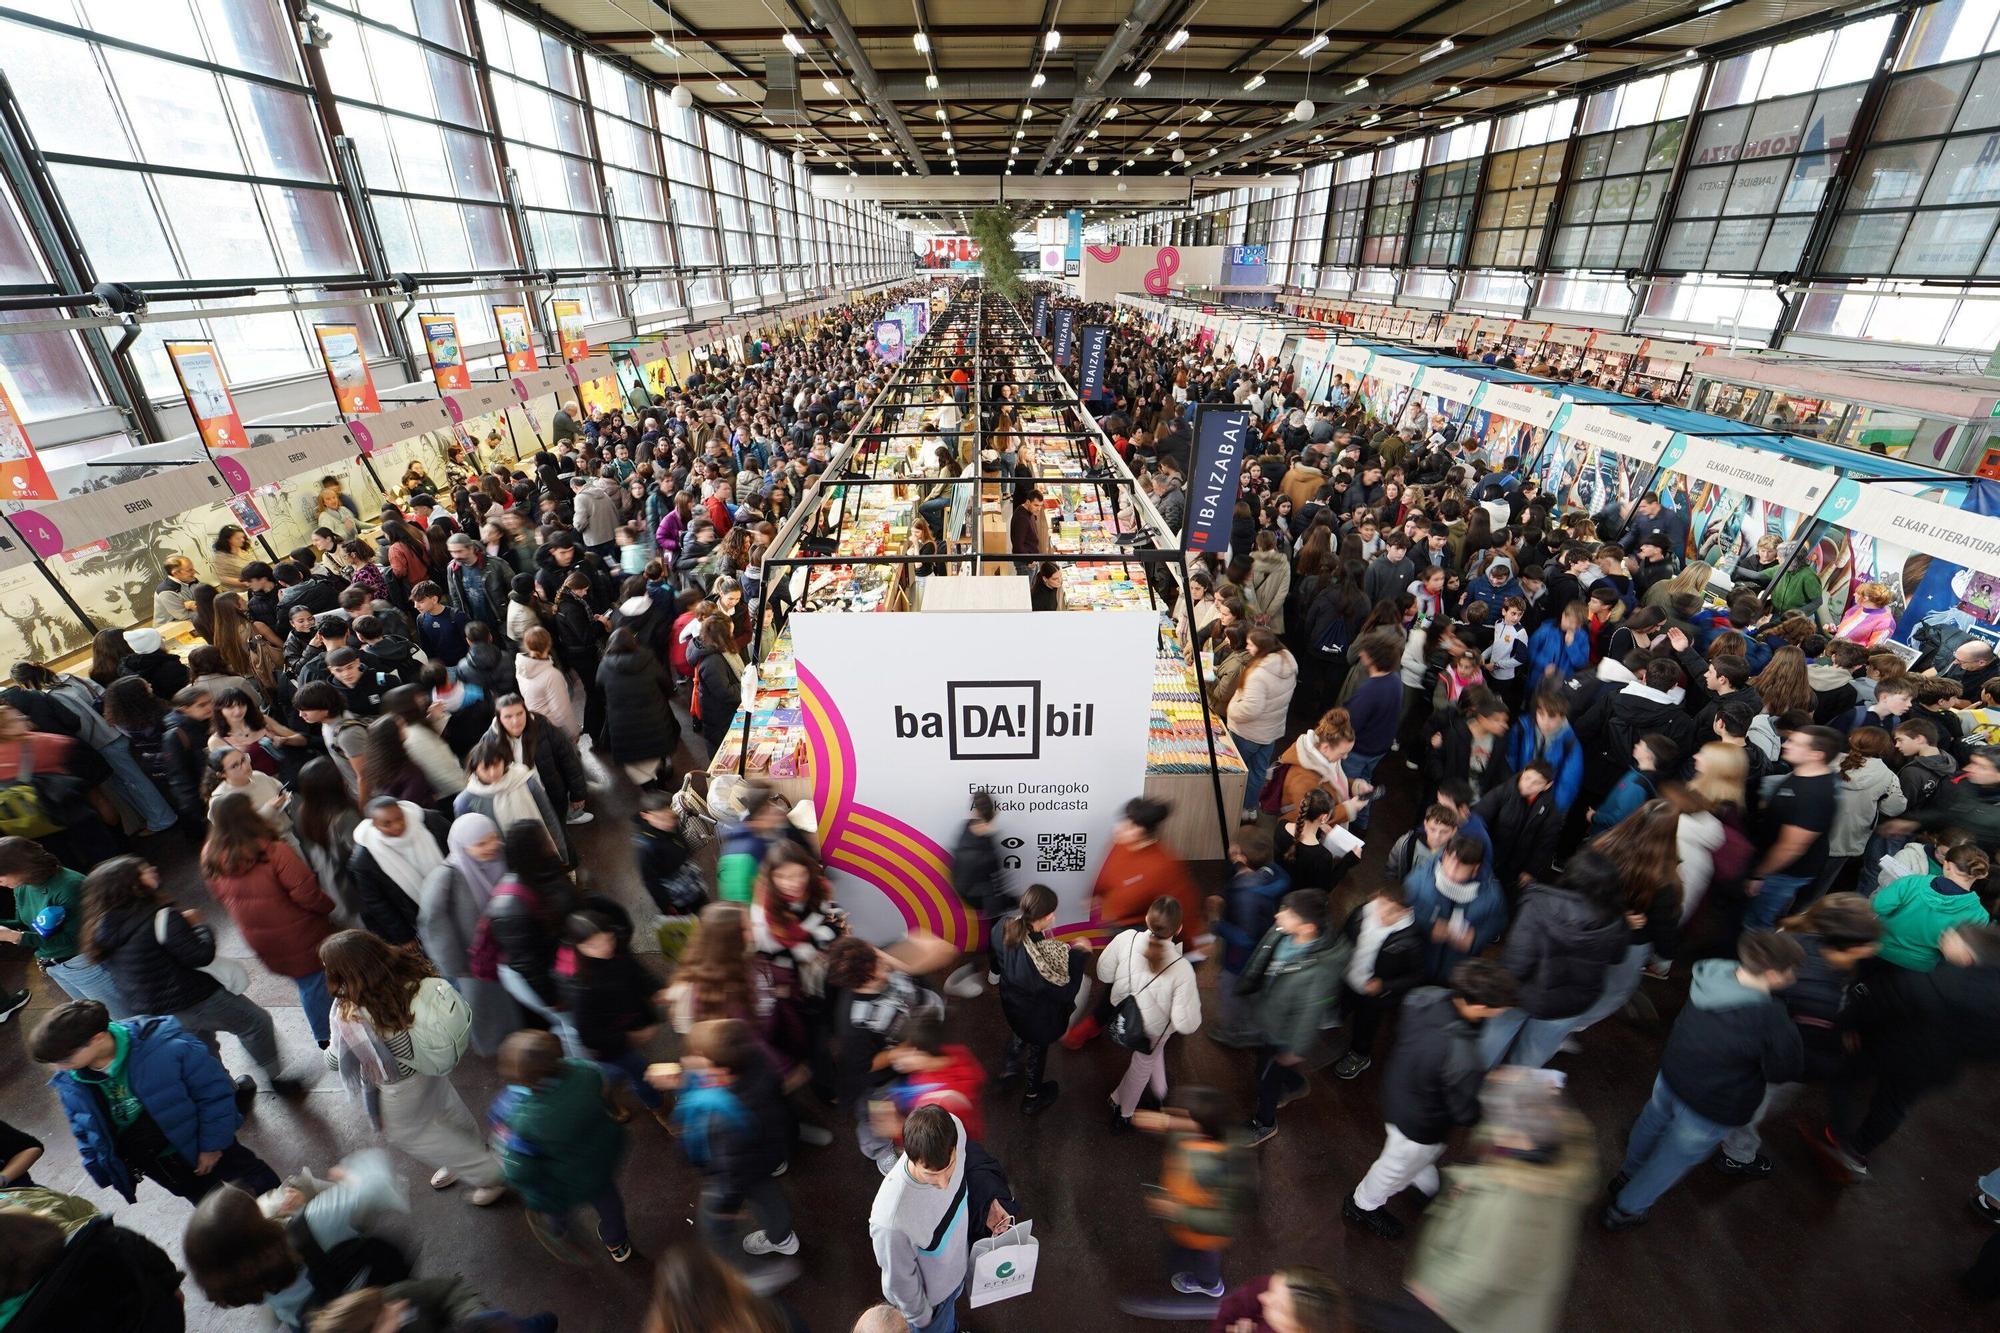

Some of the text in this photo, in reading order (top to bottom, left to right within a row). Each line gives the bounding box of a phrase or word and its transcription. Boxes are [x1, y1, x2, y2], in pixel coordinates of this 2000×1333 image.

[1067, 263, 1078, 272] DA!
[1036, 297, 1047, 330] IBAIZABAL
[1057, 311, 1072, 357] IBAIZABAL
[1084, 328, 1106, 387] IBAIZABAL
[1584, 423, 1632, 443] ELKAR LITERATURA
[288, 451, 308, 464] EREIN
[1196, 415, 1244, 527] IBAIZABAL
[1706, 460, 1775, 488] ELKAR LITERATURA
[12, 488, 39, 498] erein
[124, 498, 153, 515] EREIN
[1834, 494, 1851, 512] 81
[38, 527, 50, 540] 4
[1892, 515, 2000, 557] ELKAR LITERATURA
[969, 781, 1090, 796] Entzun Durangoko
[1029, 799, 1089, 813] podcasta
[984, 1273, 1026, 1288] erein
